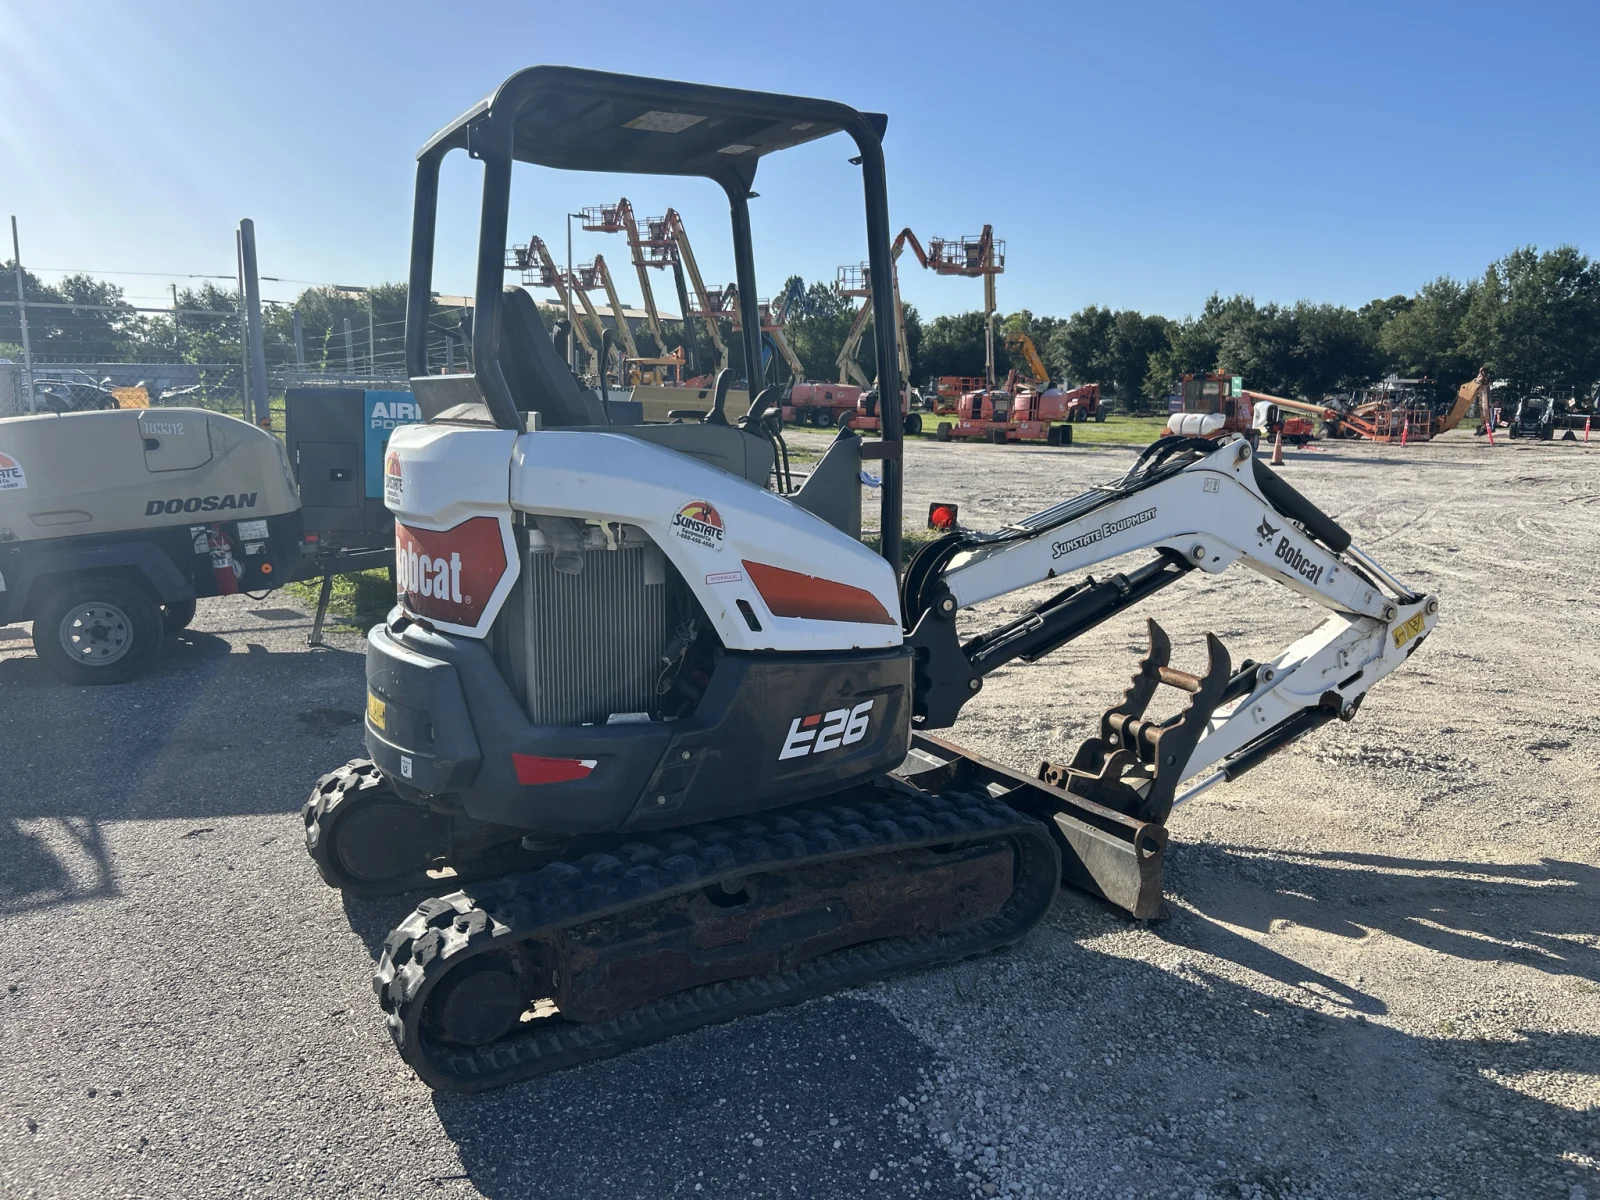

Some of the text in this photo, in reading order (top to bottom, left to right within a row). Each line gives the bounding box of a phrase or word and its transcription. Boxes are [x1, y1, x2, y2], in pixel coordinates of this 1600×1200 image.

[144, 492, 258, 516] DOOSAN
[673, 513, 723, 541] SUNSTATE
[682, 527, 706, 540] Equipment
[1052, 507, 1157, 559] SUNSTATE EQUIPMENT
[1275, 536, 1324, 585] Bobcat
[710, 574, 739, 582] HYDRAULIC
[778, 699, 874, 760] E26
